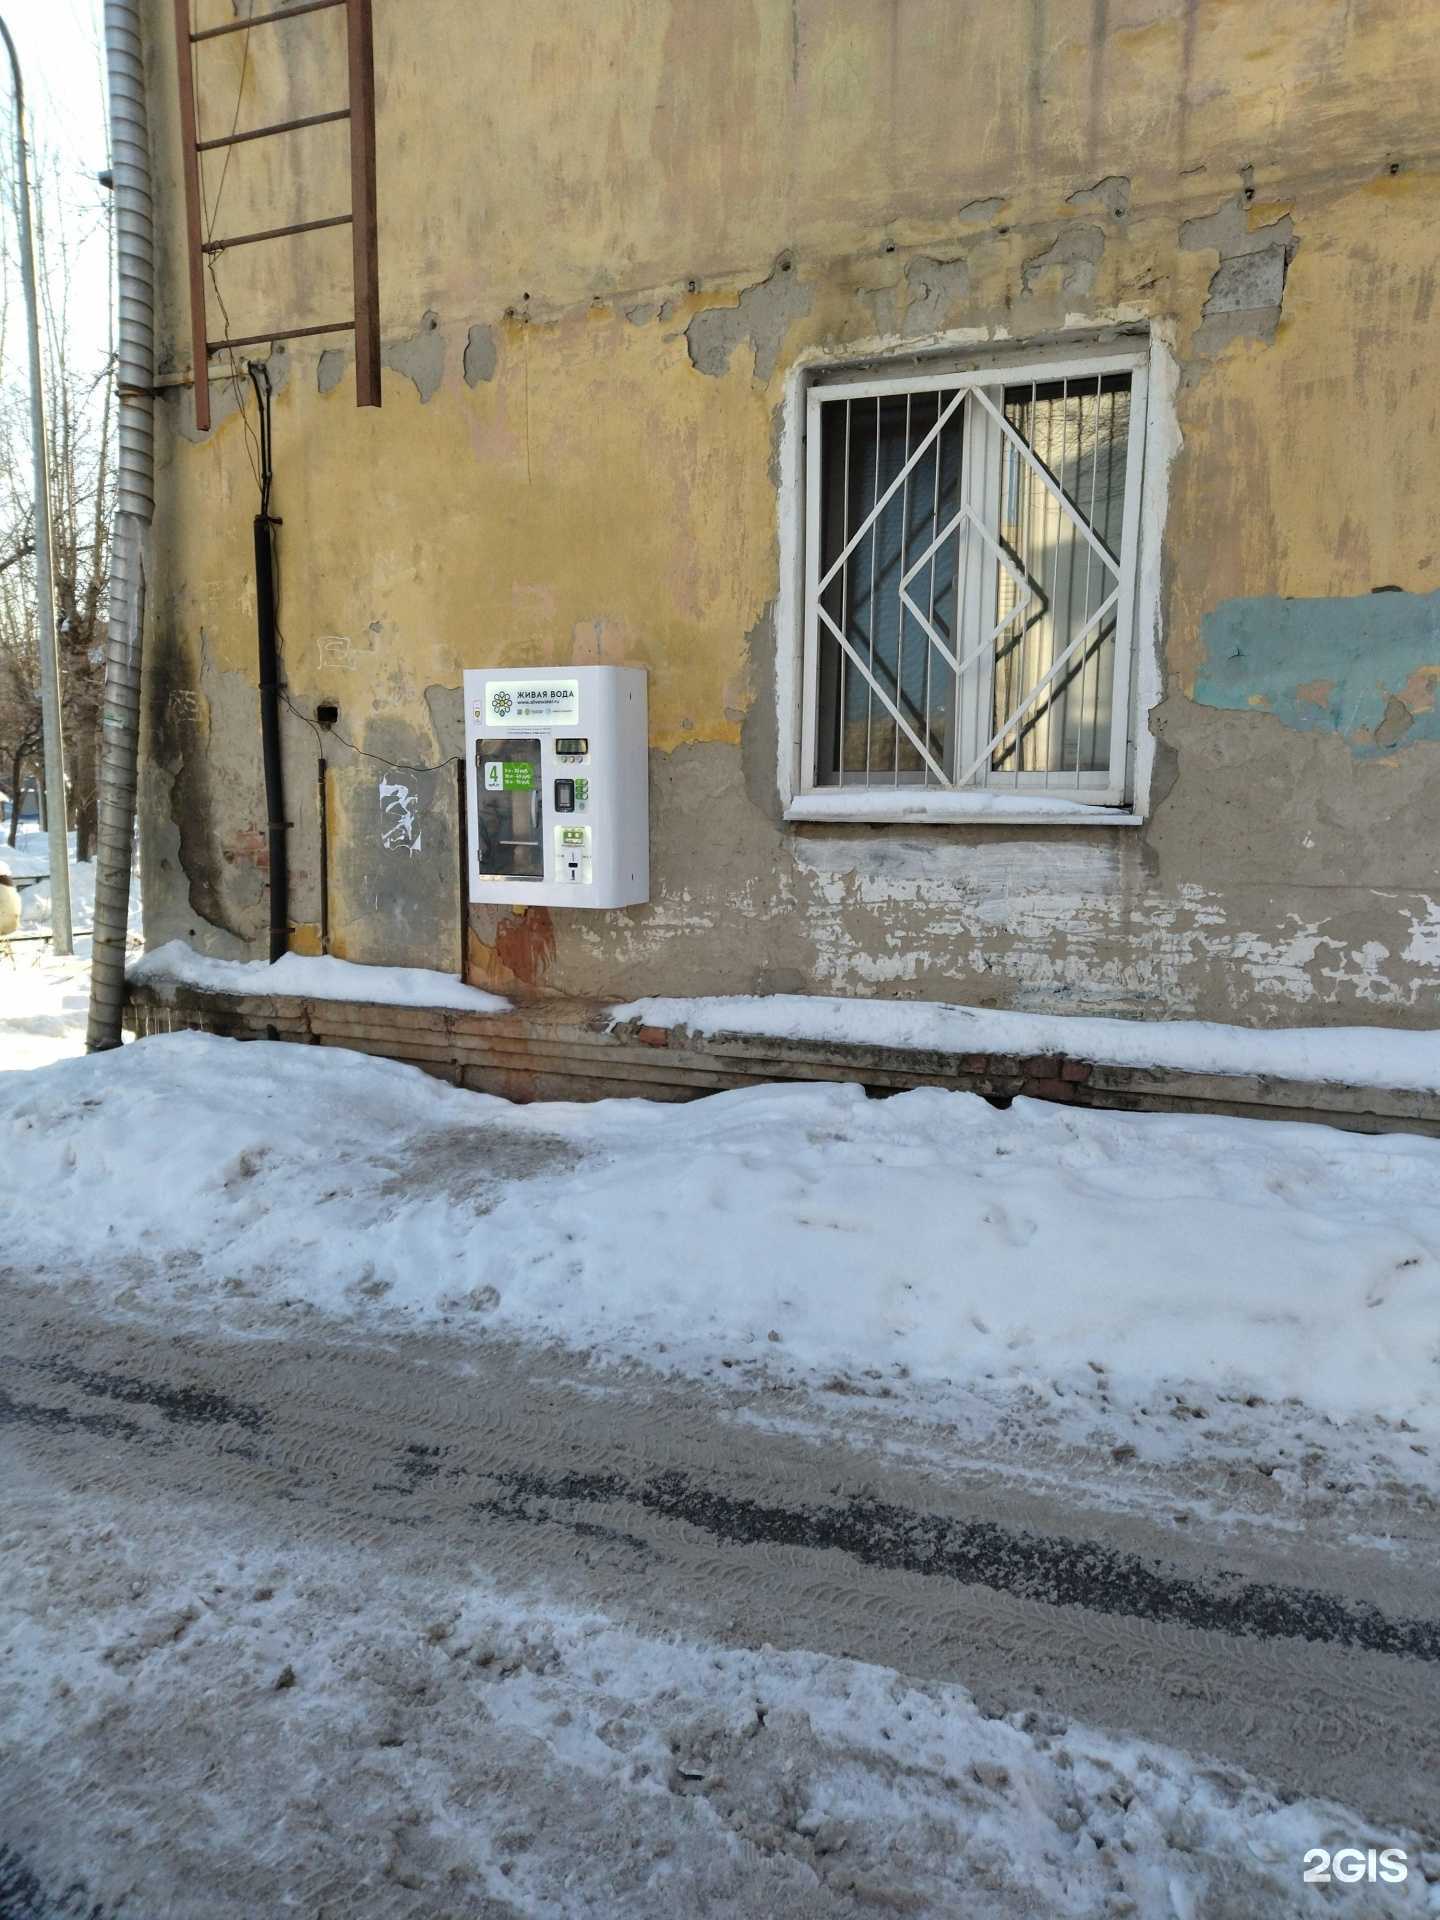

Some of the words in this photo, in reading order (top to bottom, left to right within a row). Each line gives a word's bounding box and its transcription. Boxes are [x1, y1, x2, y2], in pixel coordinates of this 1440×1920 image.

[517, 690, 548, 699] ЖИВАЯ
[550, 690, 574, 698] ВОДА
[489, 765, 498, 782] 4
